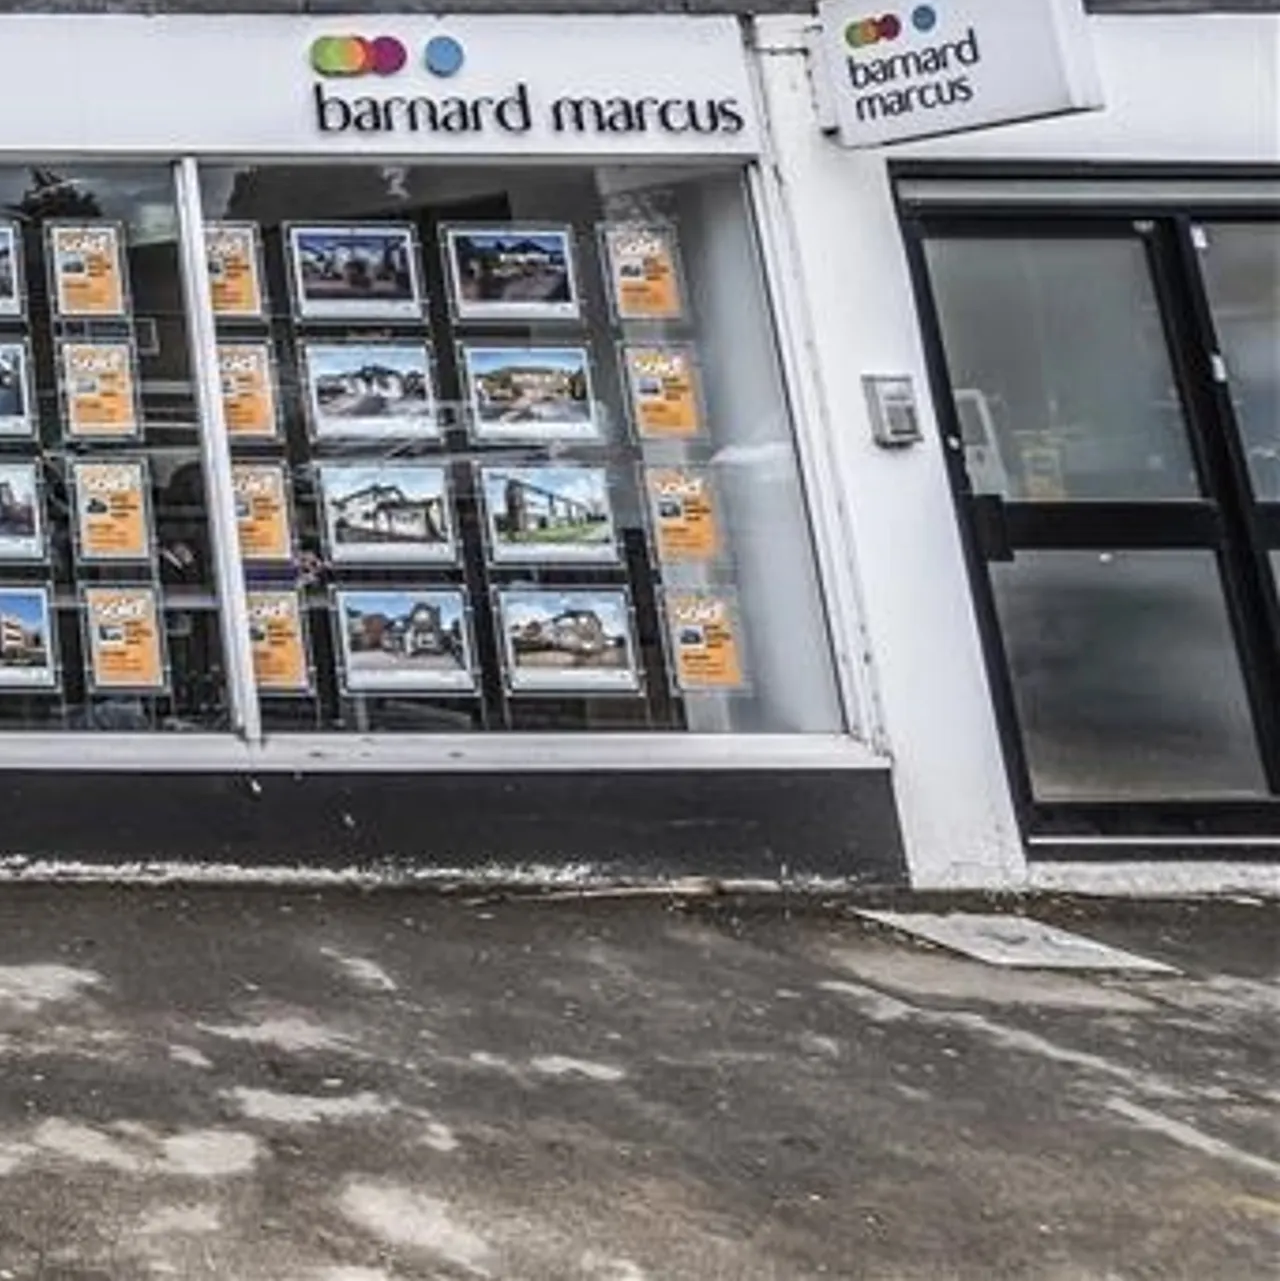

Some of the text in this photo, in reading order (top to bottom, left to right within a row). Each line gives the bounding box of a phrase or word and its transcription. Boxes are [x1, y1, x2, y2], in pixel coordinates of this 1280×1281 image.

[846, 26, 981, 90] barnard
[314, 82, 746, 133] barnard marcus
[855, 76, 974, 122] marcus
